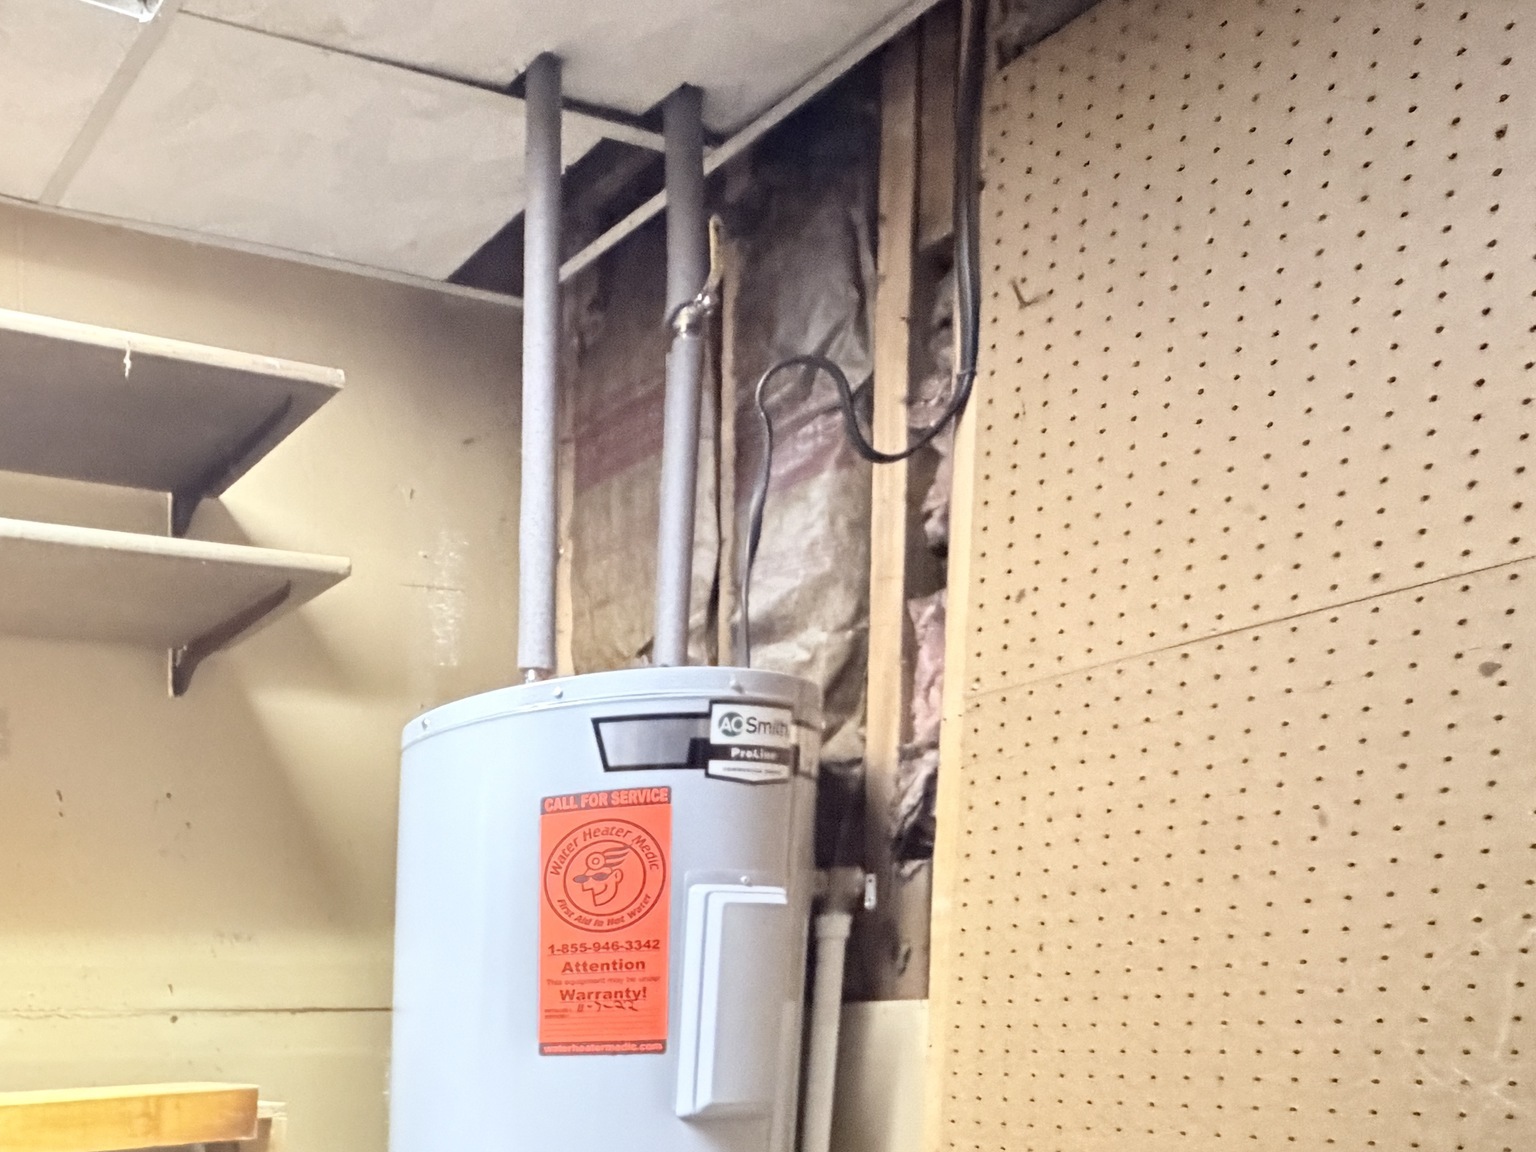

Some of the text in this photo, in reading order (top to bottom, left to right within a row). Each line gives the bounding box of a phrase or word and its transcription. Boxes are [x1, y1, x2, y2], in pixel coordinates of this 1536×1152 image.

[745, 716, 788, 737] Smith
[544, 787, 668, 812] CALL FOR SERVICE
[549, 826, 659, 876] Water Heater Medic
[547, 939, 661, 954] 1-855-946-3342
[561, 959, 646, 973] Attention
[559, 986, 648, 1001] Warranty!
